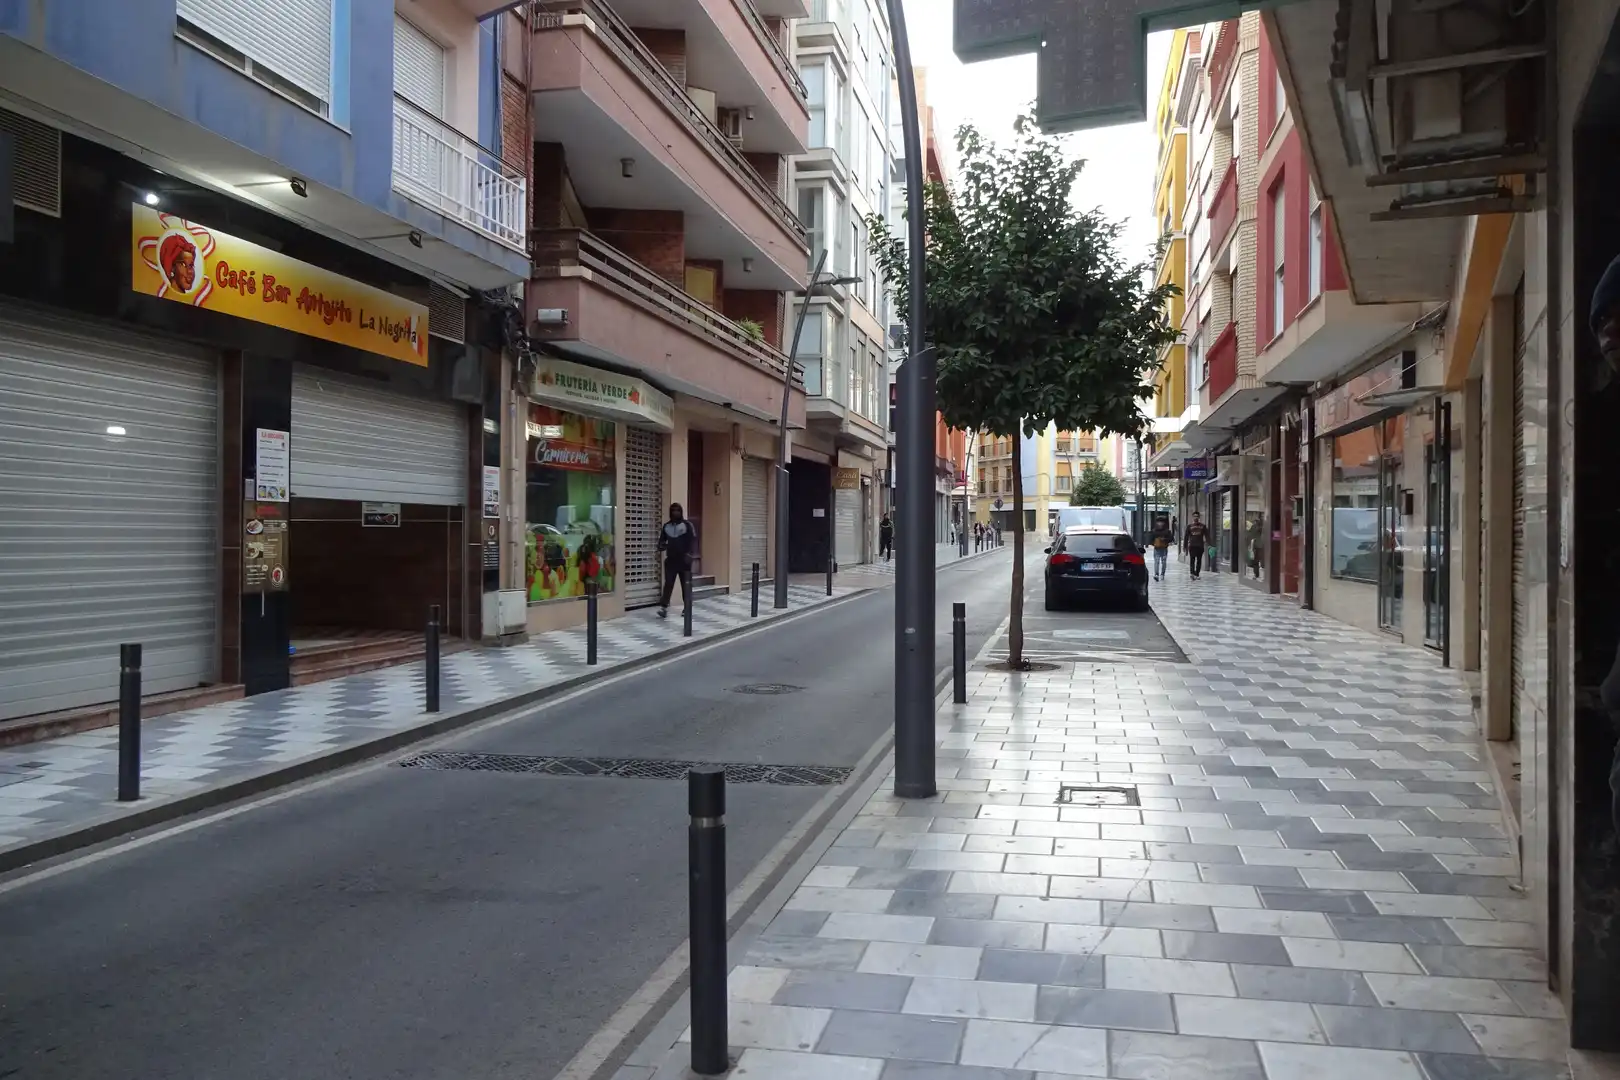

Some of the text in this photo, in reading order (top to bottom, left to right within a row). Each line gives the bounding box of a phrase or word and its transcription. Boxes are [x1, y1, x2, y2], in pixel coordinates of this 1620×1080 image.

[215, 260, 256, 296] Café
[262, 273, 291, 304] Bar
[359, 308, 375, 330] La
[378, 315, 417, 343] Negrita
[601, 383, 628, 400] VERDE
